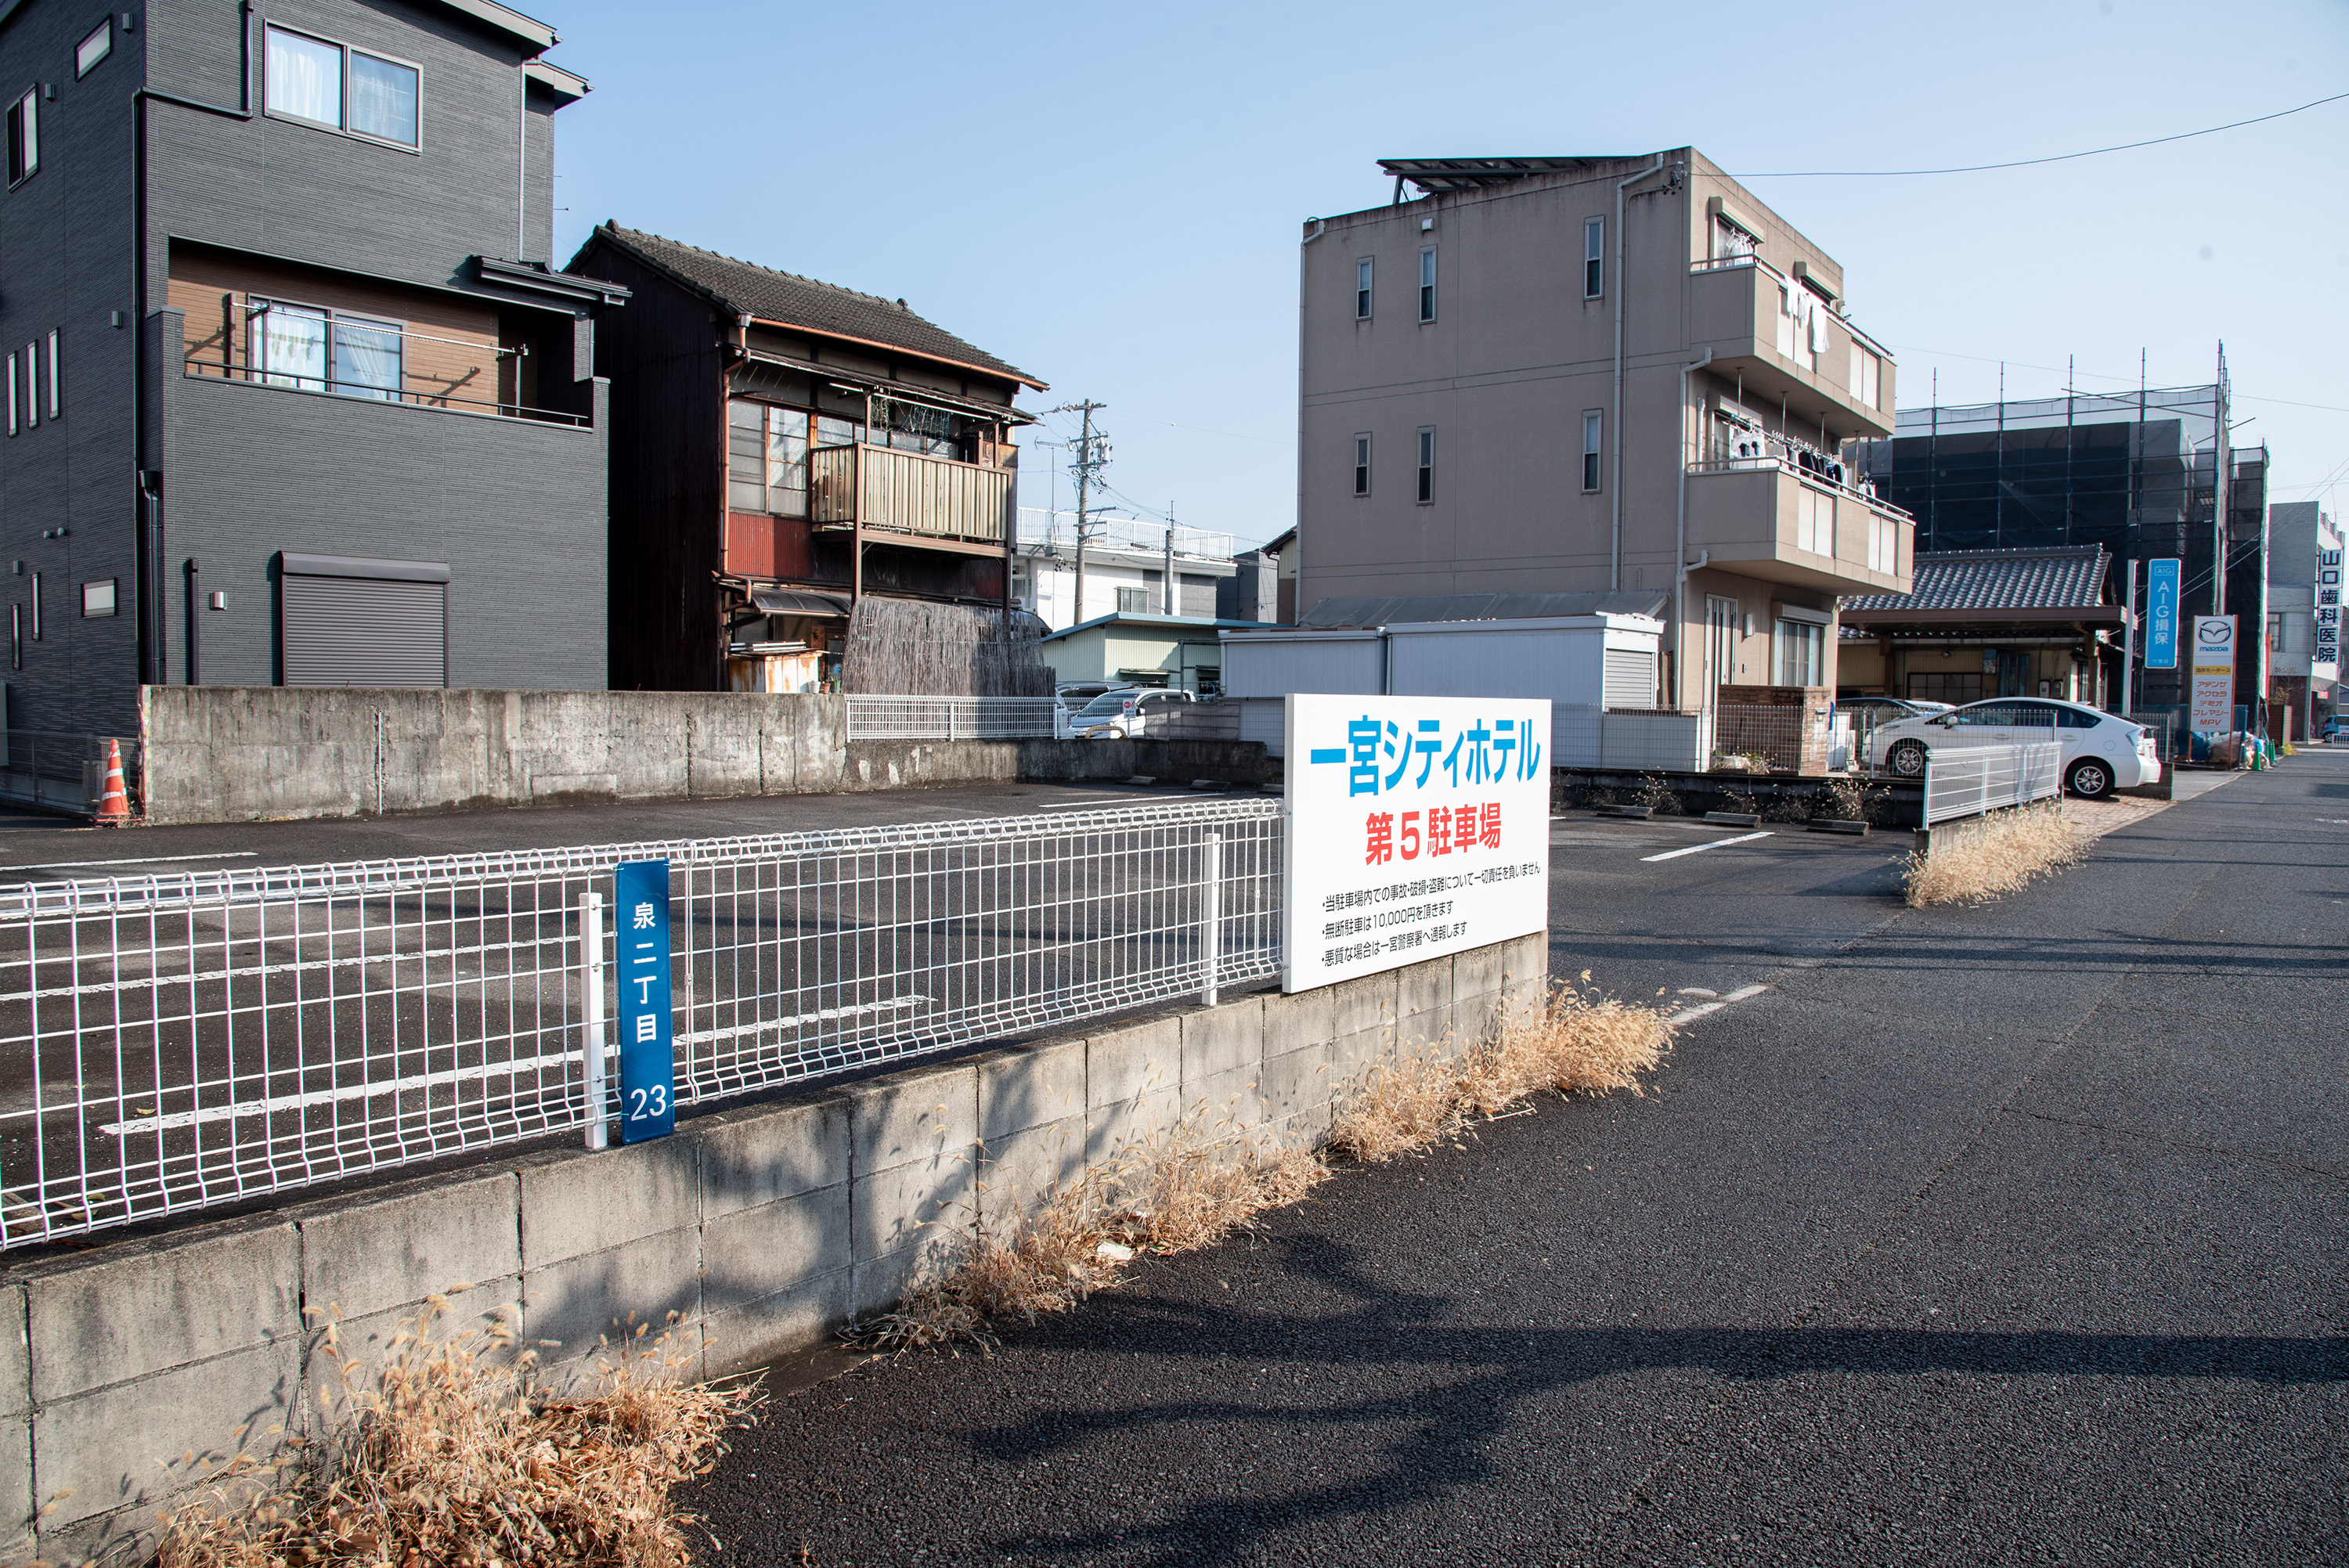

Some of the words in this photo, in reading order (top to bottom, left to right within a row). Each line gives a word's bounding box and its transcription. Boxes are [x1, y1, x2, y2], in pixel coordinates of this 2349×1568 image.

[2154, 581, 2170, 645] AIG損保
[2318, 550, 2340, 662] 山口歯科医院
[1311, 715, 1541, 798] 一宮シティホテル
[1366, 802, 1502, 866] 第5駐車場
[633, 902, 657, 1044] 泉二丁目
[630, 1084, 666, 1121] 23
